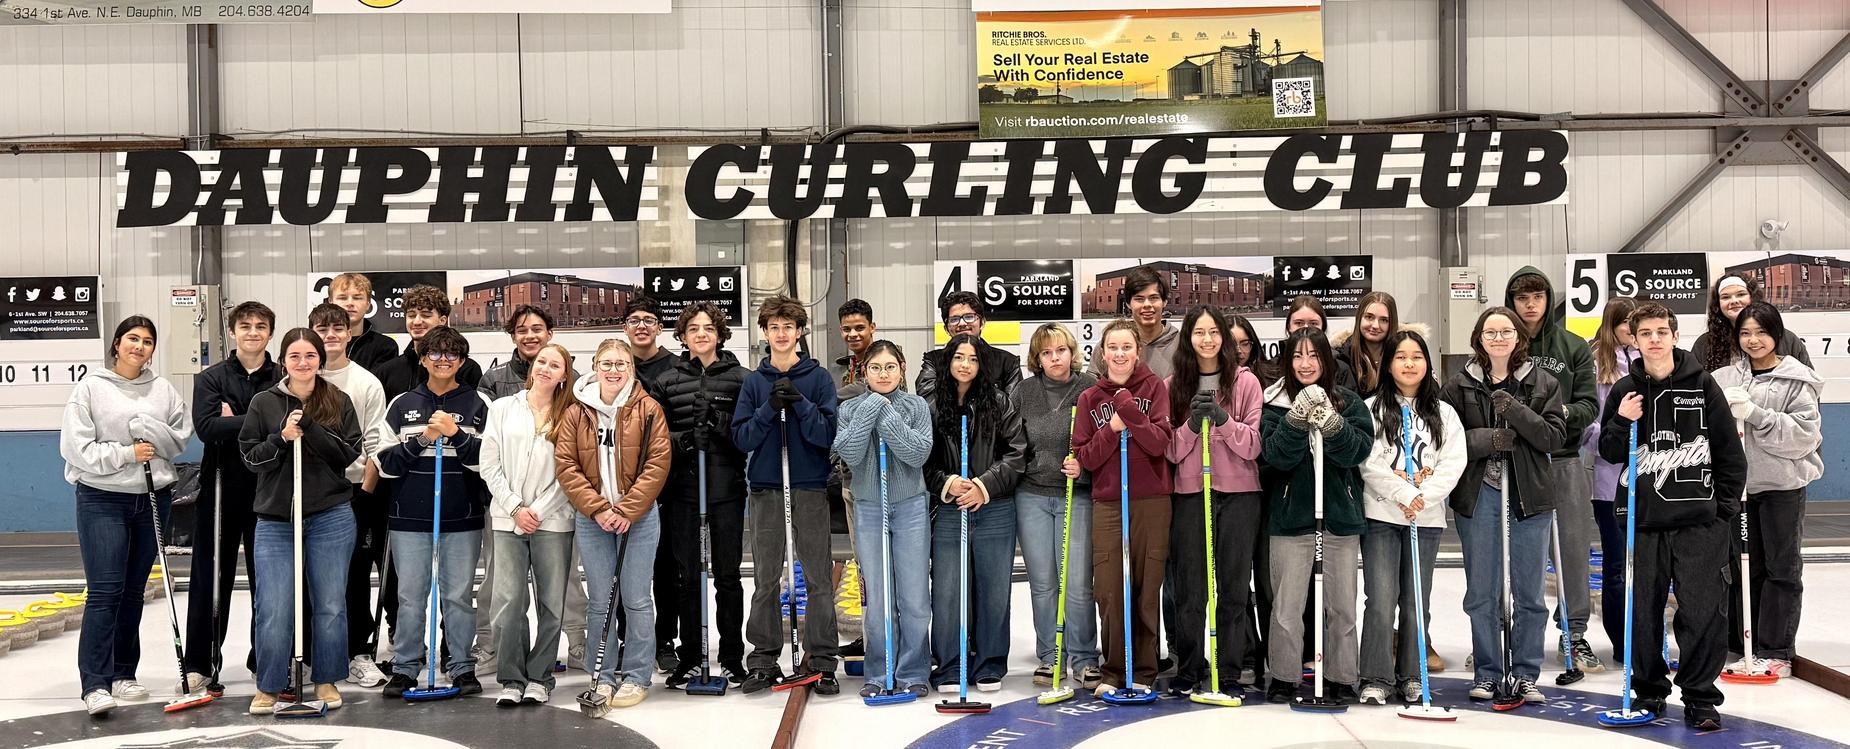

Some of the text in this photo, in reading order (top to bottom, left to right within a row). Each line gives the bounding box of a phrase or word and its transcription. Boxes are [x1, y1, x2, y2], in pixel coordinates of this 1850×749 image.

[13, 8, 38, 19] 334
[67, 7, 91, 18] Ave.
[96, 6, 121, 18] N.E.
[126, 6, 177, 20] Dauphin,
[182, 6, 202, 16] MB
[218, 5, 310, 17] 204.638.4204
[993, 52, 1149, 66] Sell Your Real Estate
[994, 68, 1124, 82] With Confidence
[995, 112, 1188, 128] Visit rbauction.com/realestate
[116, 130, 1570, 228] DAUPHIN CURLING CLUB
[938, 266, 962, 308] 4
[1013, 285, 1066, 296] SOURCE
[1571, 259, 1599, 313] 5
[1645, 278, 1701, 290] SOURCE
[1082, 324, 1092, 340] 3
[1822, 338, 1831, 354] 7
[32, 365, 49, 382] 11
[68, 364, 87, 382] 12
[1090, 397, 1152, 429] LON
